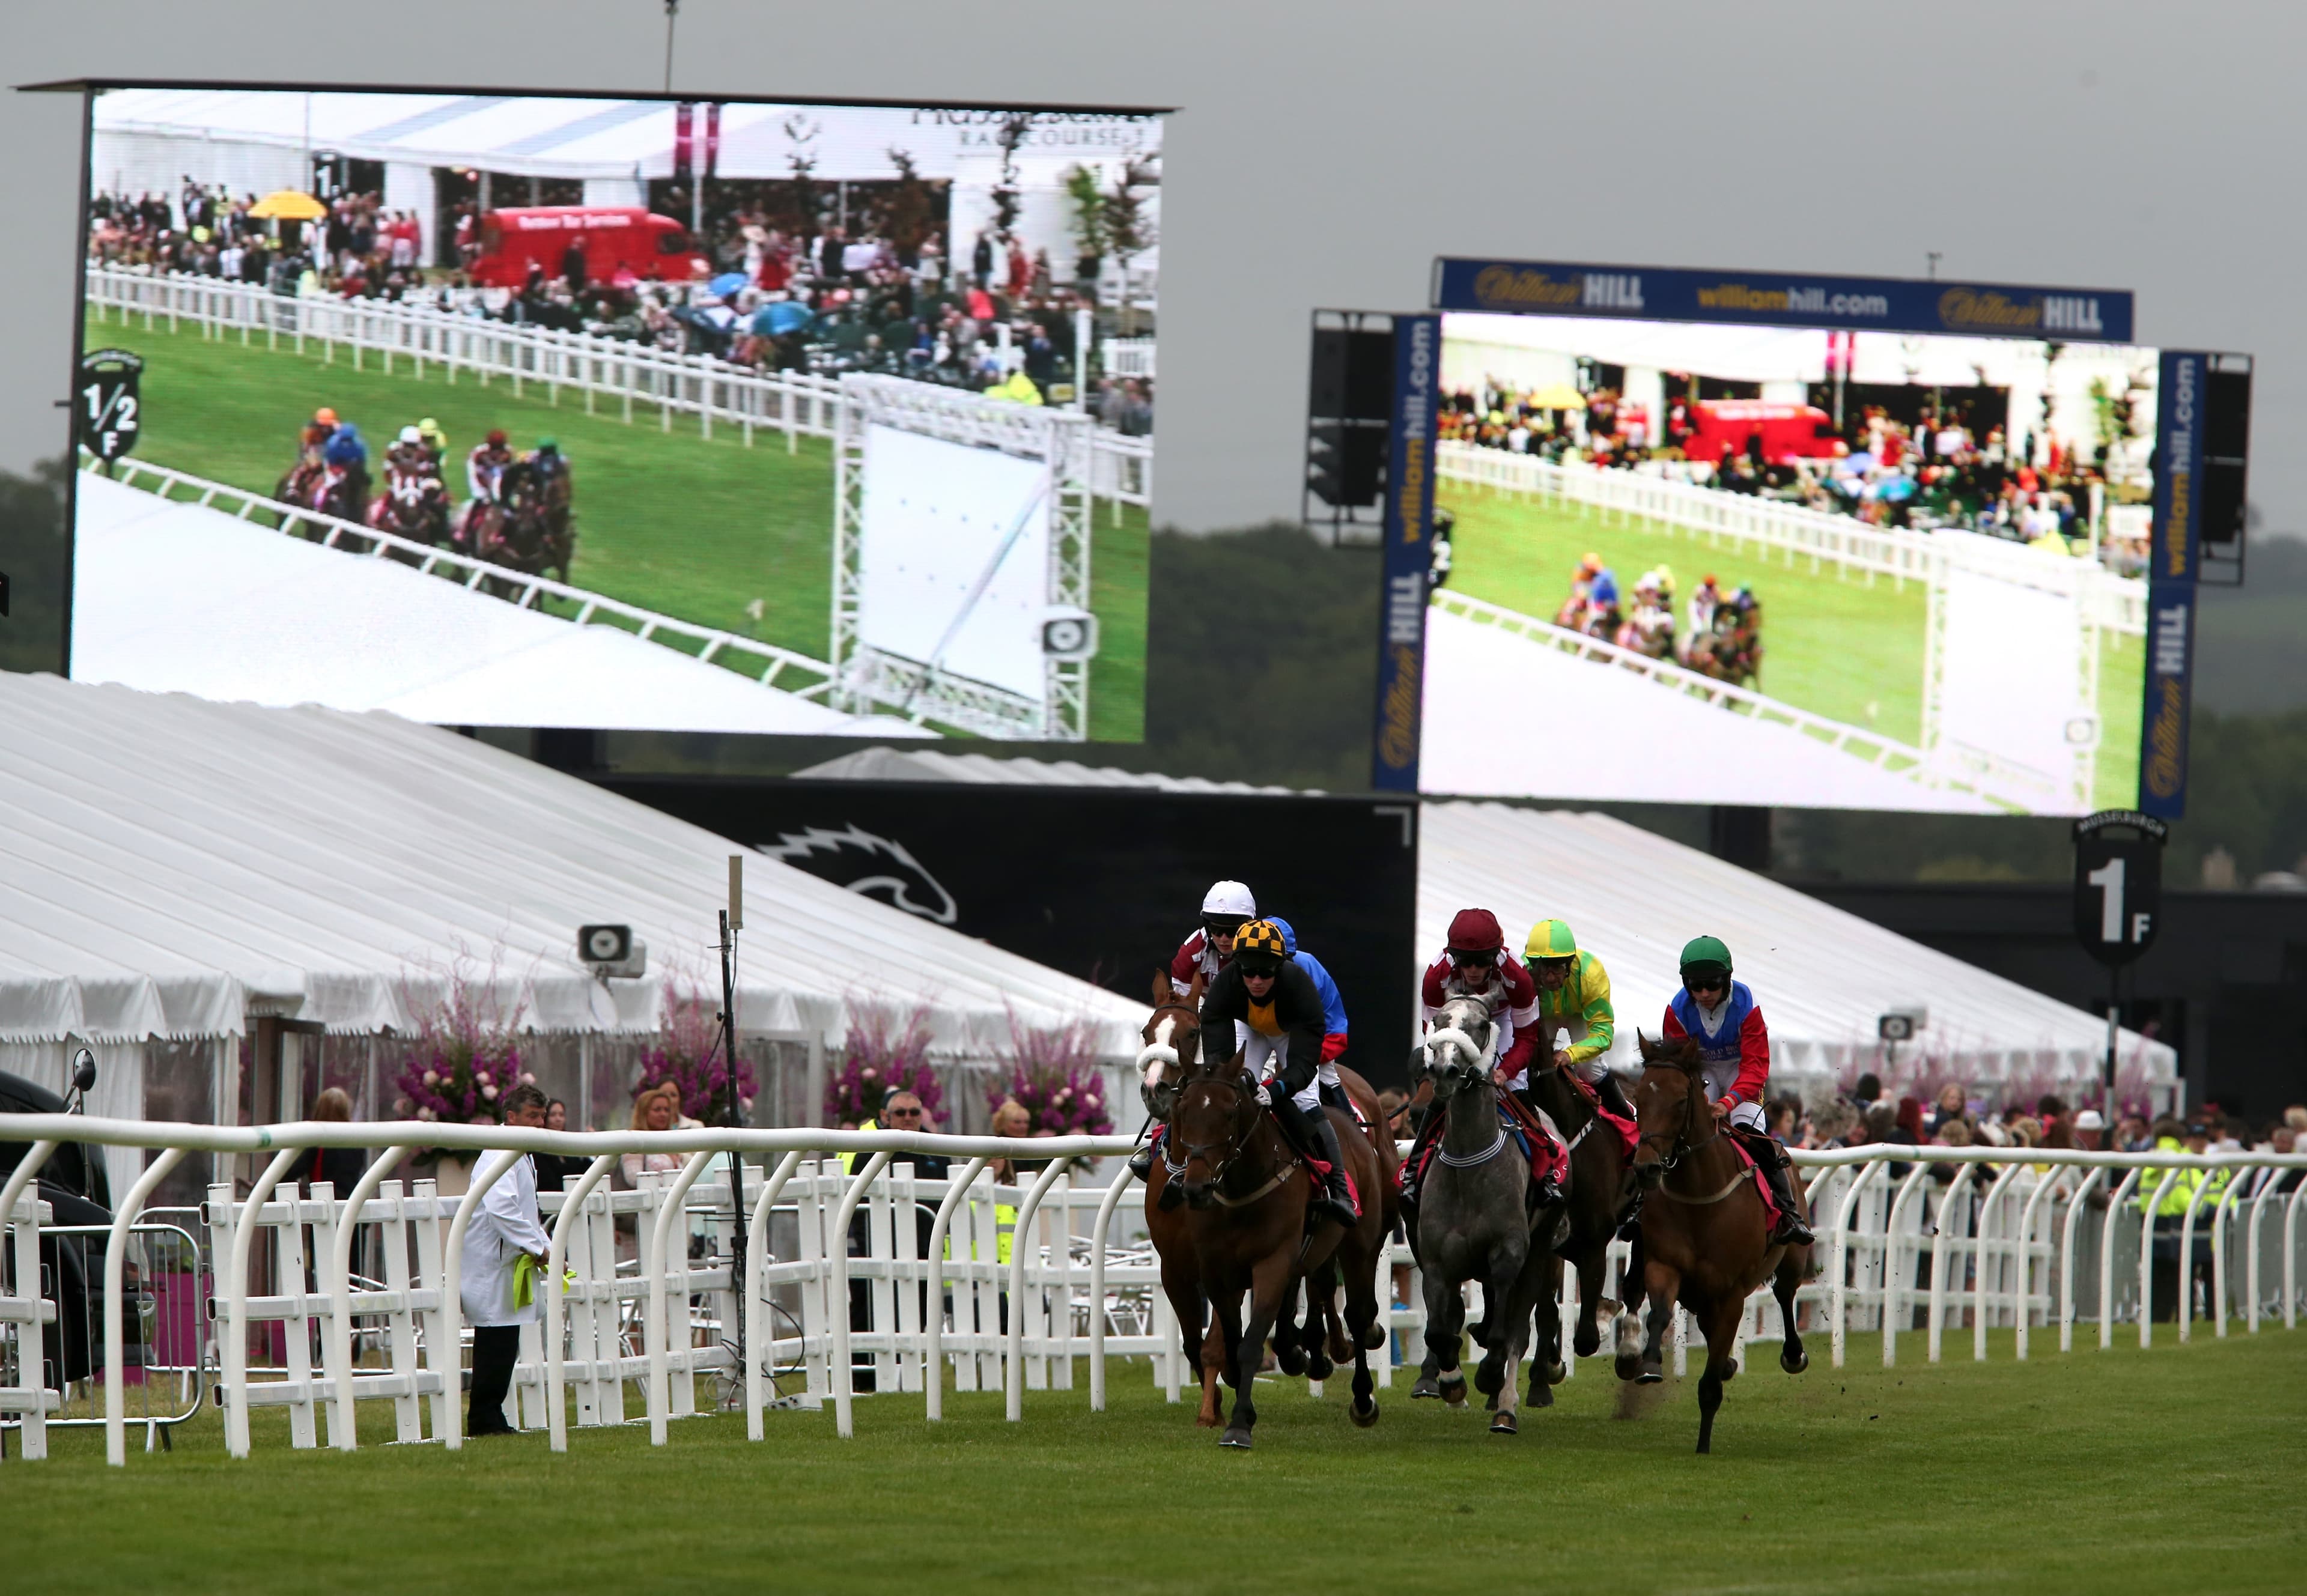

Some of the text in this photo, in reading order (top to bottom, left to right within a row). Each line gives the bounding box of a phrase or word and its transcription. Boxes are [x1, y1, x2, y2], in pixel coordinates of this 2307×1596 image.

[1582, 273, 1645, 309] HILL
[1697, 284, 1888, 317] williamhill.com
[2044, 295, 2103, 331] HILL
[102, 431, 118, 456] F
[1388, 571, 1423, 643] HILL
[2155, 603, 2187, 674] HILL
[2089, 858, 2151, 944] 1 F
